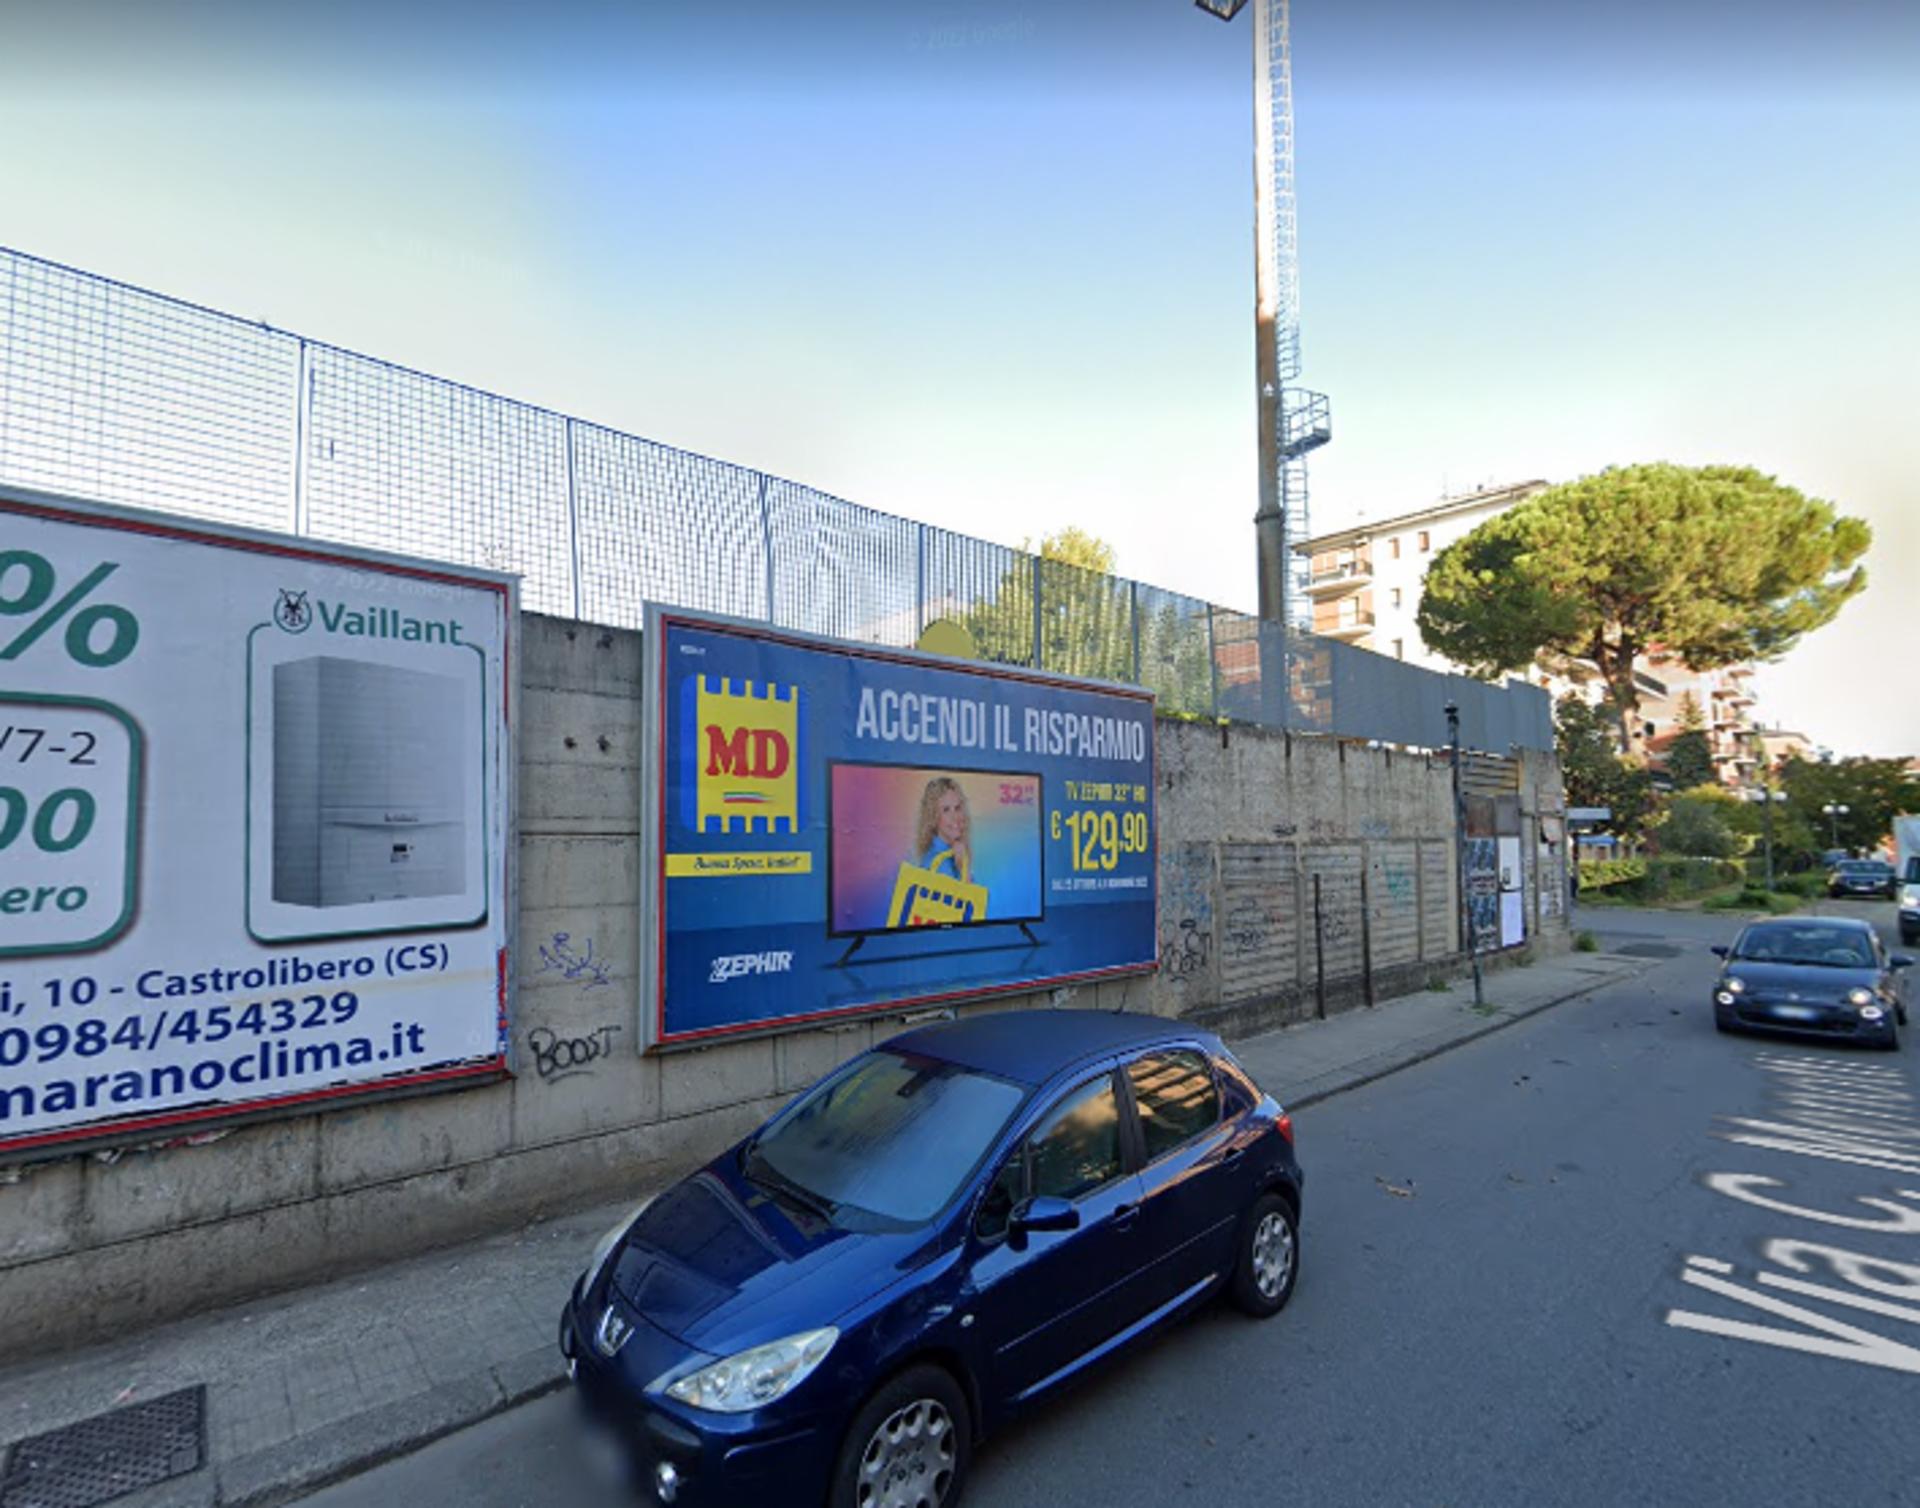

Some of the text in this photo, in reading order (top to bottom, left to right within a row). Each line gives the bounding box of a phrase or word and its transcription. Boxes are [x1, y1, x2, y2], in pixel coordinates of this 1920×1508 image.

[0, 550, 139, 668] %
[318, 601, 464, 646] Vaillant
[705, 724, 790, 780] MD
[856, 687, 1146, 763] ACCENDI IL RISPARMIO
[0, 886, 88, 914] ero
[43, 976, 97, 1008] 10
[136, 957, 375, 999] Castrolibero
[385, 943, 450, 977] (CS)
[0, 991, 359, 1067] 0984/454329
[0, 1022, 425, 1120] maranoclima.it
[1665, 1238, 1920, 1373] Via
